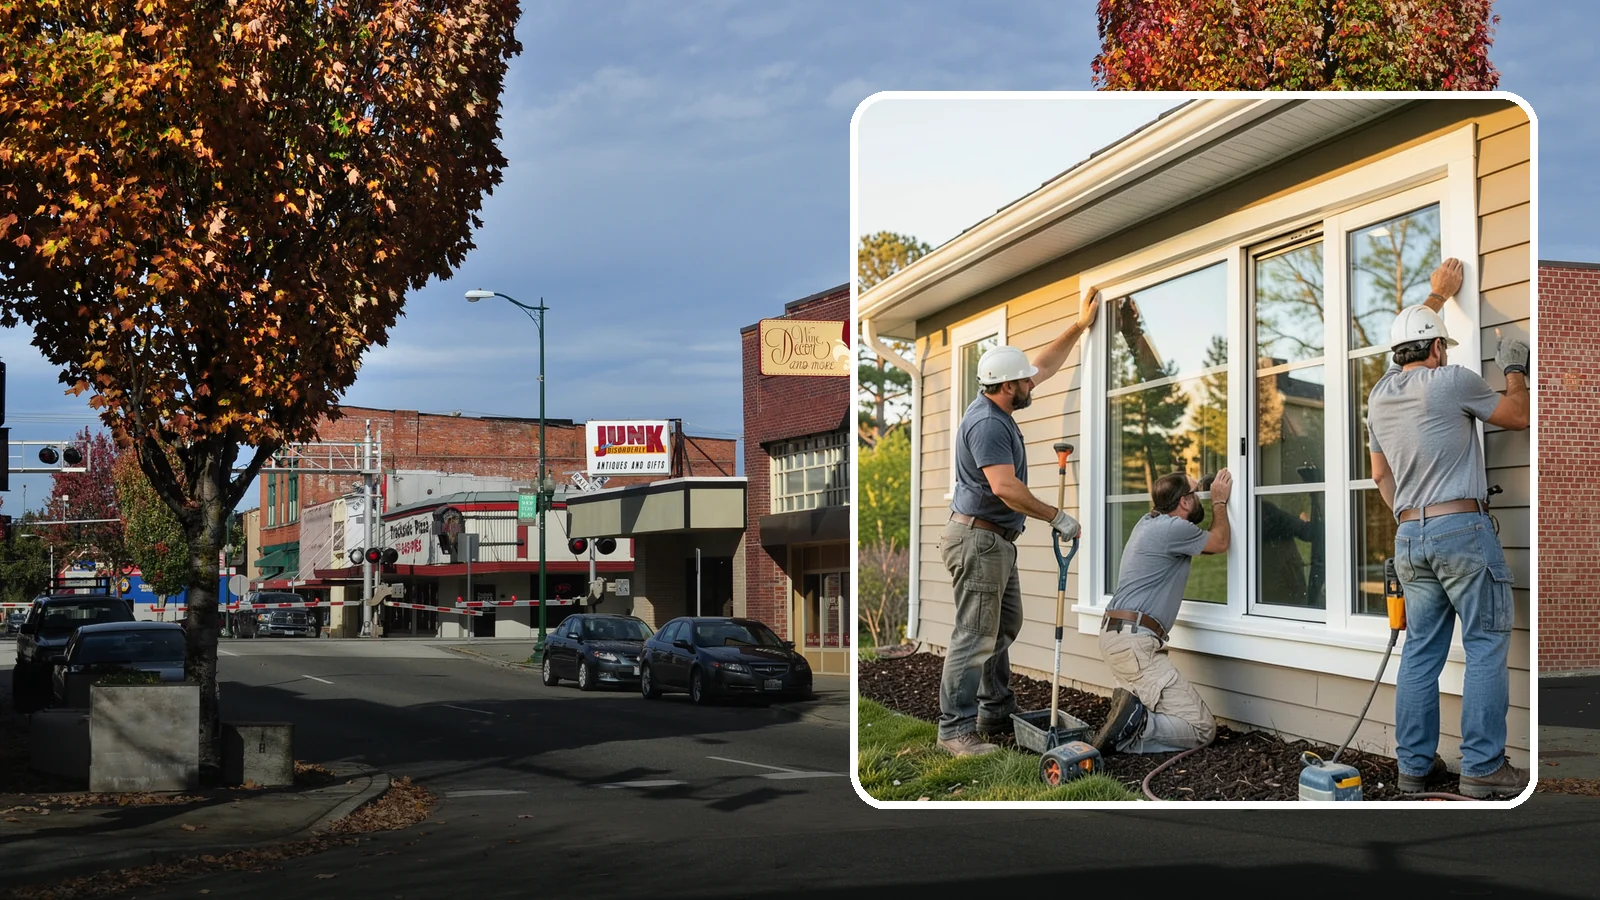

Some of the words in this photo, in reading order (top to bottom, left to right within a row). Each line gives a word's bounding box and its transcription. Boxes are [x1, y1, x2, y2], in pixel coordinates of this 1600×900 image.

[595, 425, 664, 457] JUNK
[607, 446, 646, 454] DISORDERLY
[597, 461, 628, 470] ANTIQUES
[631, 461, 644, 469] AND
[647, 461, 665, 469] GIFTS
[414, 519, 429, 534] Pizza
